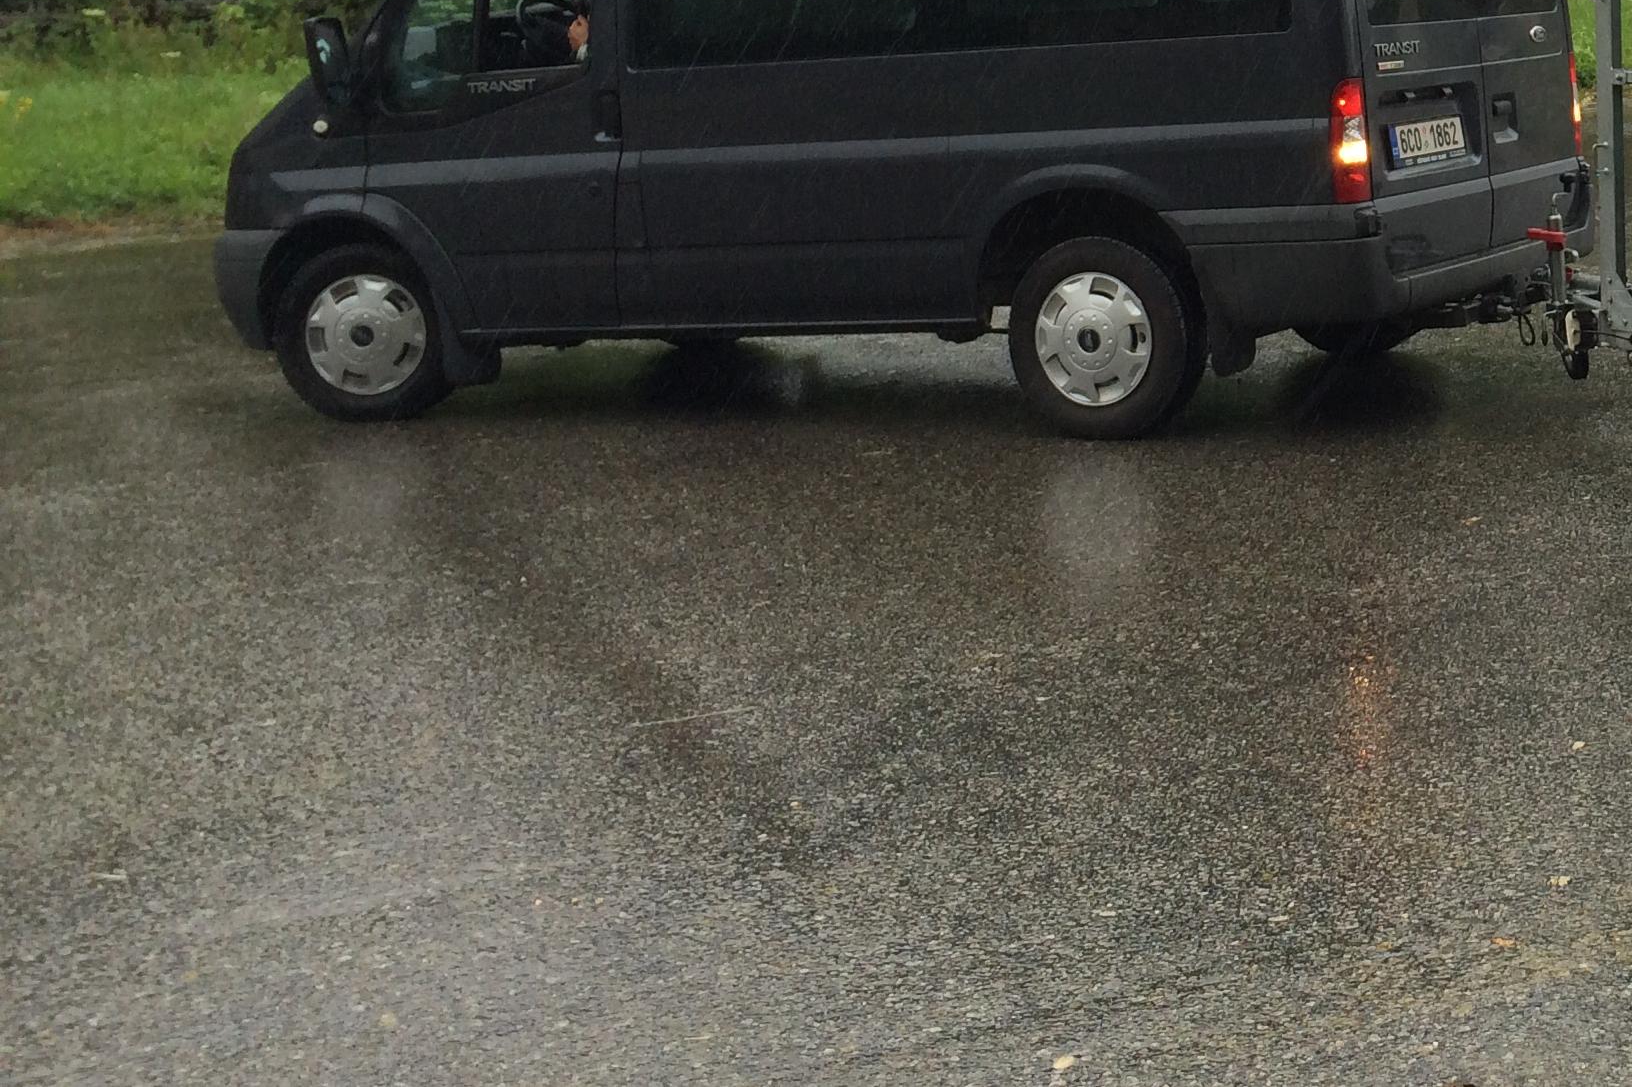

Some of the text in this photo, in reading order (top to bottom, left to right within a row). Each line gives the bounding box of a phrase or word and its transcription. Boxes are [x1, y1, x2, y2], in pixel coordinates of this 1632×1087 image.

[1373, 40, 1421, 57] TRANSIT
[466, 78, 537, 94] TRANSIT
[1429, 121, 1459, 149] 1862
